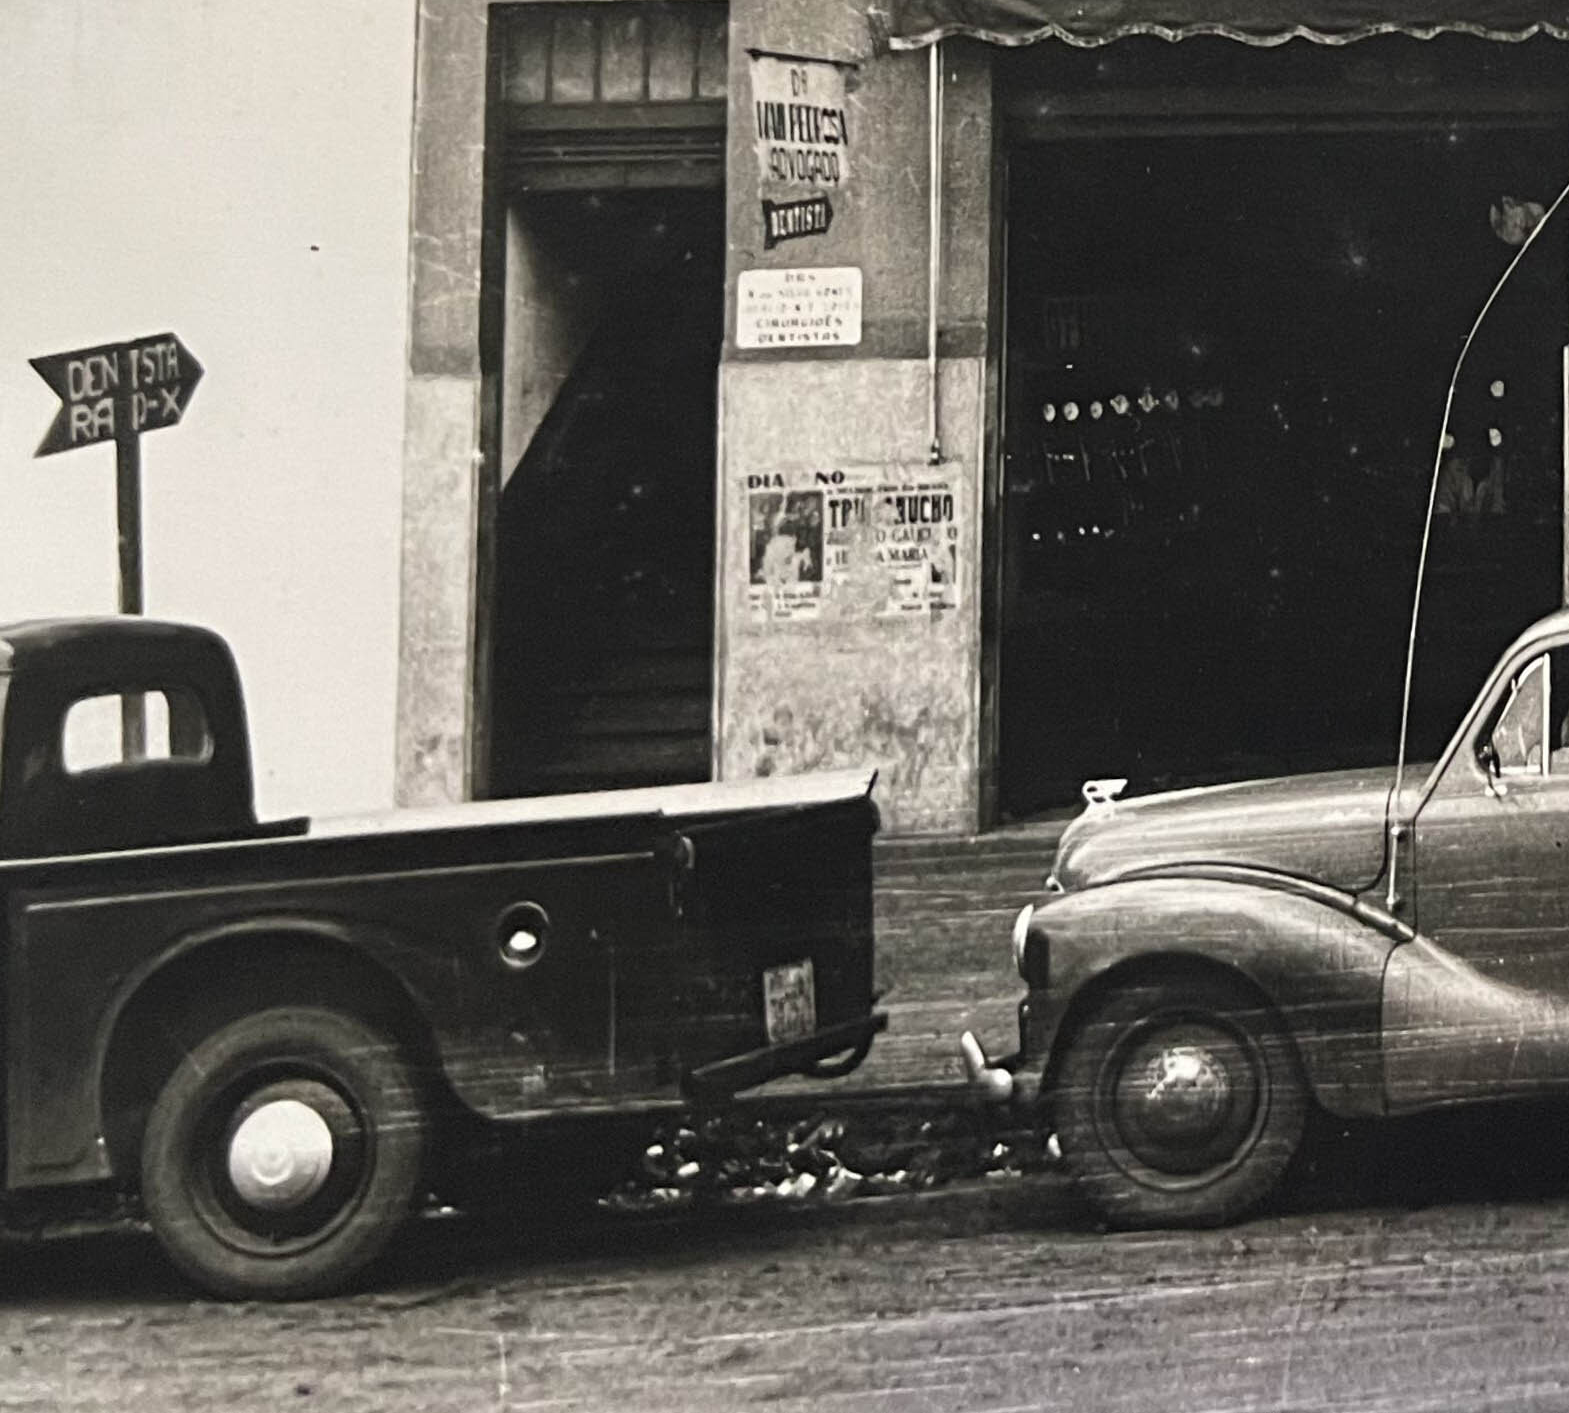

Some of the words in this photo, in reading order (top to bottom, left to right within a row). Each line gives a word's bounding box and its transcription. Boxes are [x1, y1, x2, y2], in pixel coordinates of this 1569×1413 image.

[67, 342, 180, 402] DENISTA
[748, 473, 785, 488] DIA
[815, 470, 845, 485] NO
